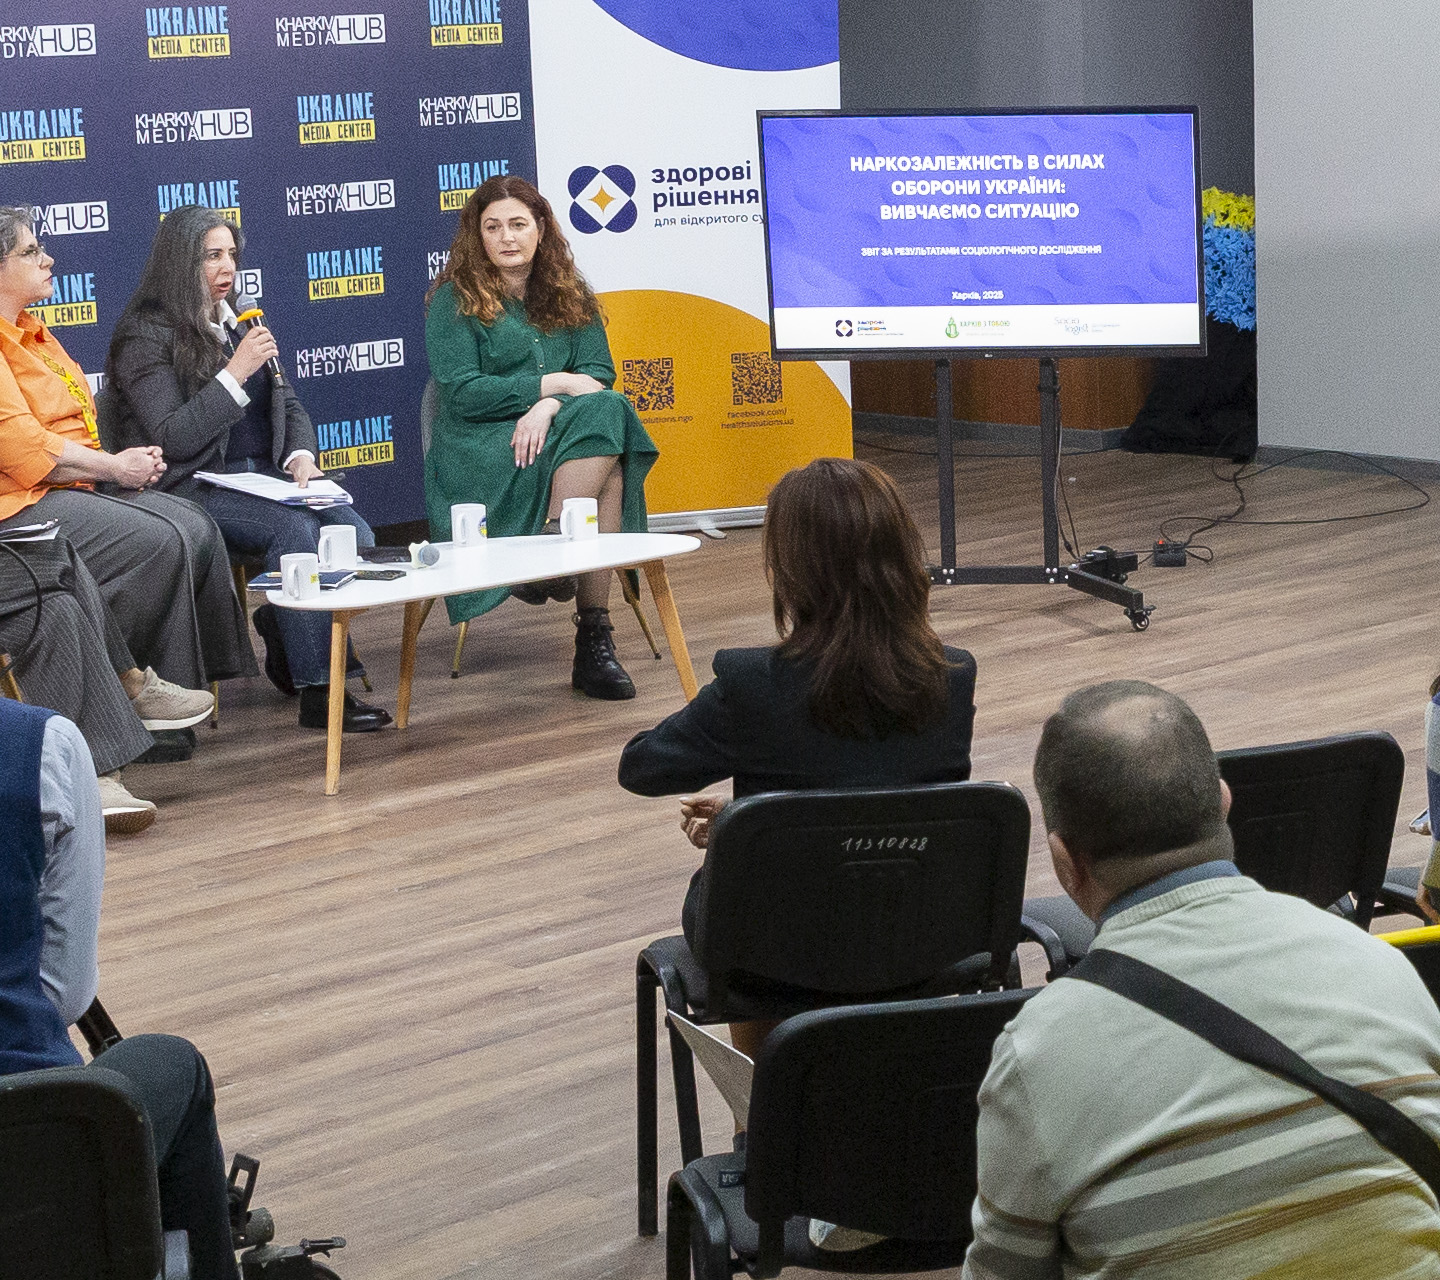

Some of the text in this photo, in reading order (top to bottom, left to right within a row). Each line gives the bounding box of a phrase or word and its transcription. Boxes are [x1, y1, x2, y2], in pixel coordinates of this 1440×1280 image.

[145, 5, 229, 36] UKRAINE
[275, 15, 336, 32] KHARKIV
[39, 27, 94, 53] HUB
[276, 17, 383, 47] MEDIA HUB
[434, 26, 500, 42] MEDIA CENTER
[152, 36, 227, 54] MEDIA CENTER
[850, 153, 1105, 172] НАРКОЗАЛЕЖНІСТЬ В СИЛАХ
[651, 160, 751, 186] здорові
[891, 175, 1066, 195] ОБОРОНИ УКРАЇНИ:
[653, 186, 760, 212] рішення
[880, 202, 1080, 220] ВИВЧАЄМО СИТУАЦІЮ
[654, 218, 676, 228] для
[681, 215, 748, 226] відкритого
[894, 247, 960, 256] РЕЗУЛЬТАТАМИ
